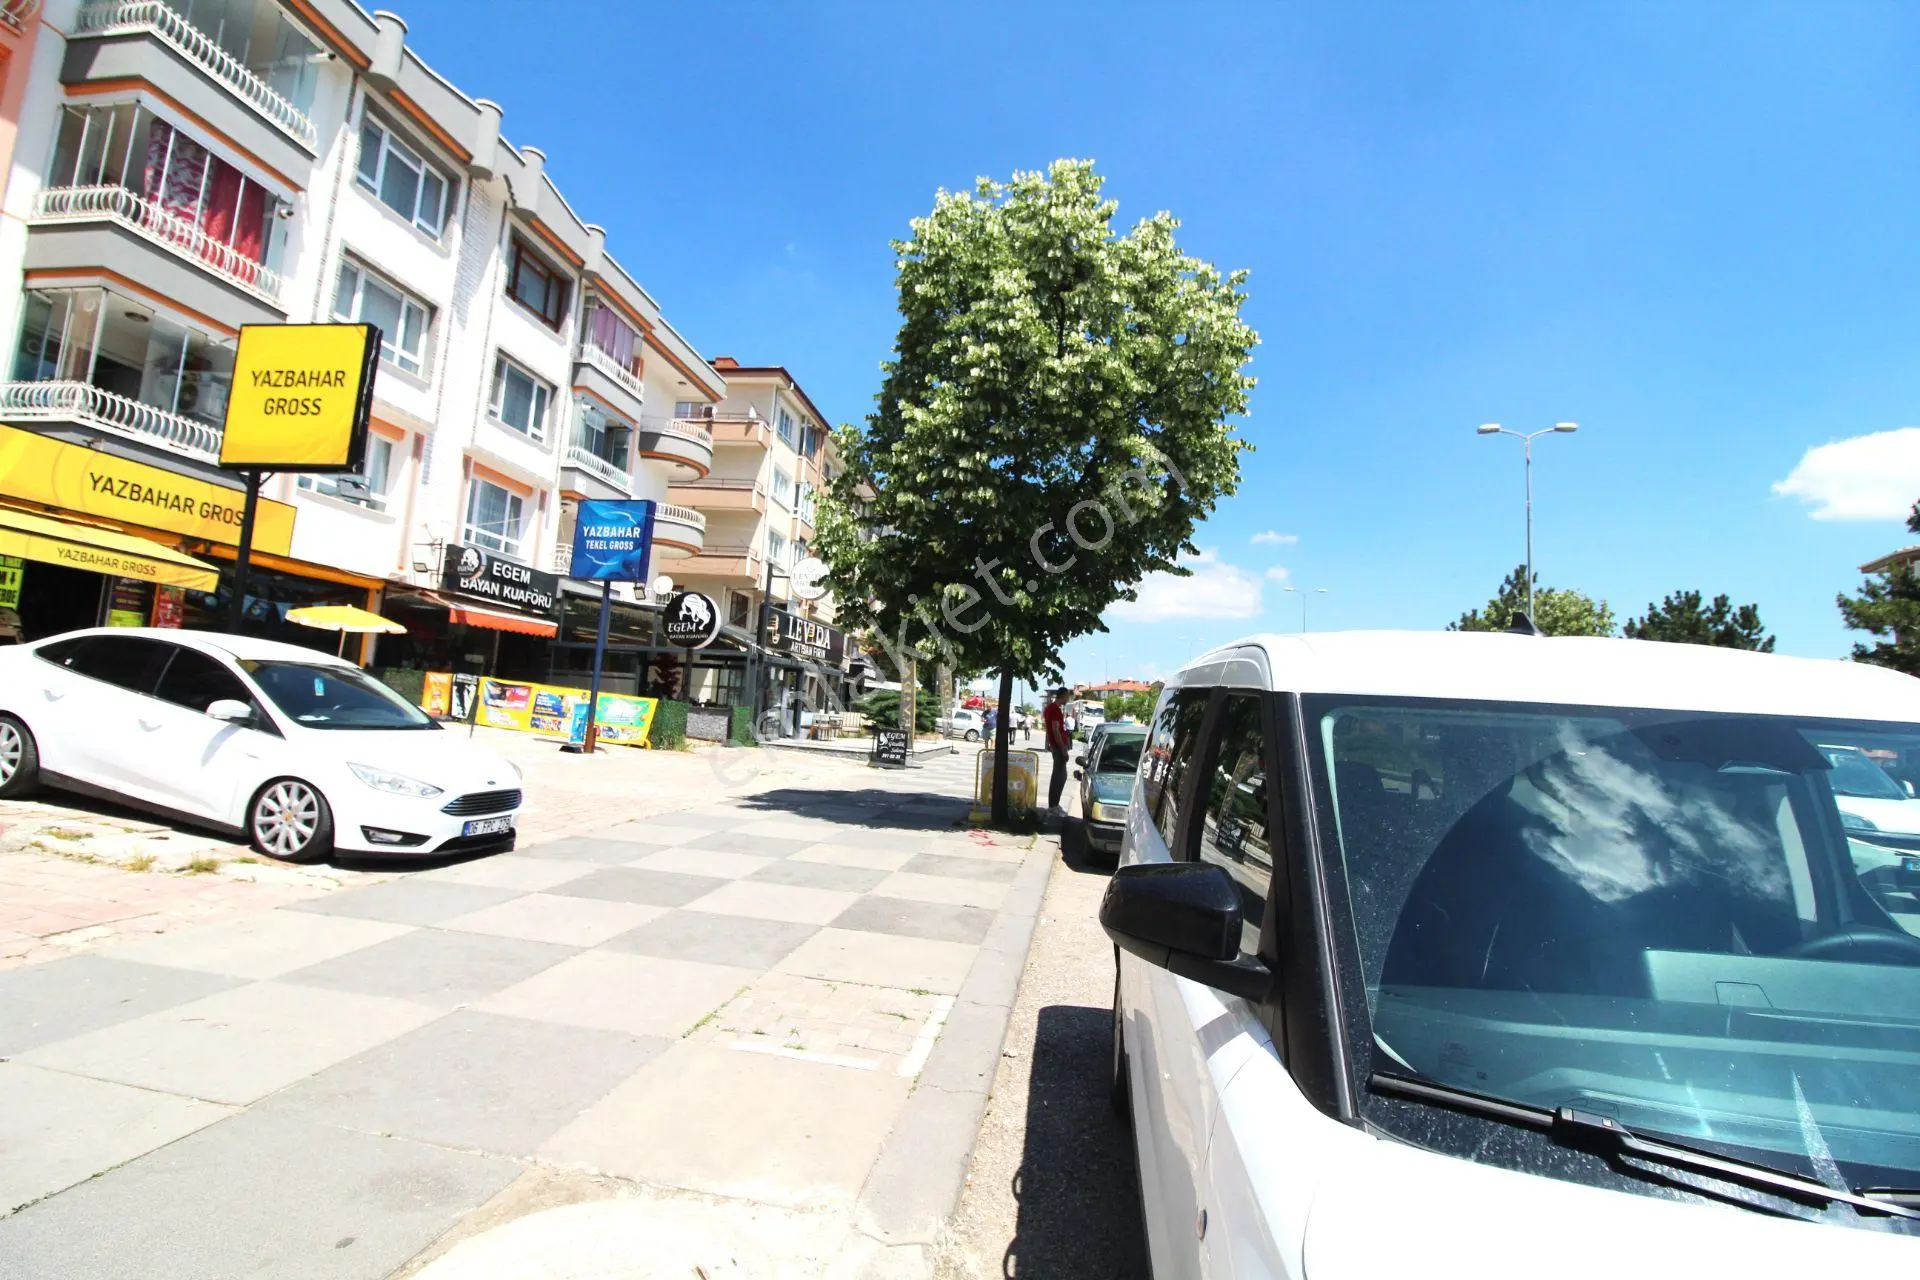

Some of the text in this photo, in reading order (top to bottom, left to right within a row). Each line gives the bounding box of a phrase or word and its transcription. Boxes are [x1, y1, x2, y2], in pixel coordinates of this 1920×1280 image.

[251, 370, 345, 388] YAZBAHAR
[264, 398, 322, 415] GROSS
[89, 472, 245, 527] YAZBAHAR GROS
[583, 526, 641, 538] YAZBAHAR
[586, 540, 634, 551] TEKEL GROSS
[57, 547, 157, 576] YAZBAHAR GROSS
[492, 561, 531, 585] EGEM
[460, 577, 552, 609] BAYAN KUAFÖRÜ
[668, 621, 696, 632] EGEM
